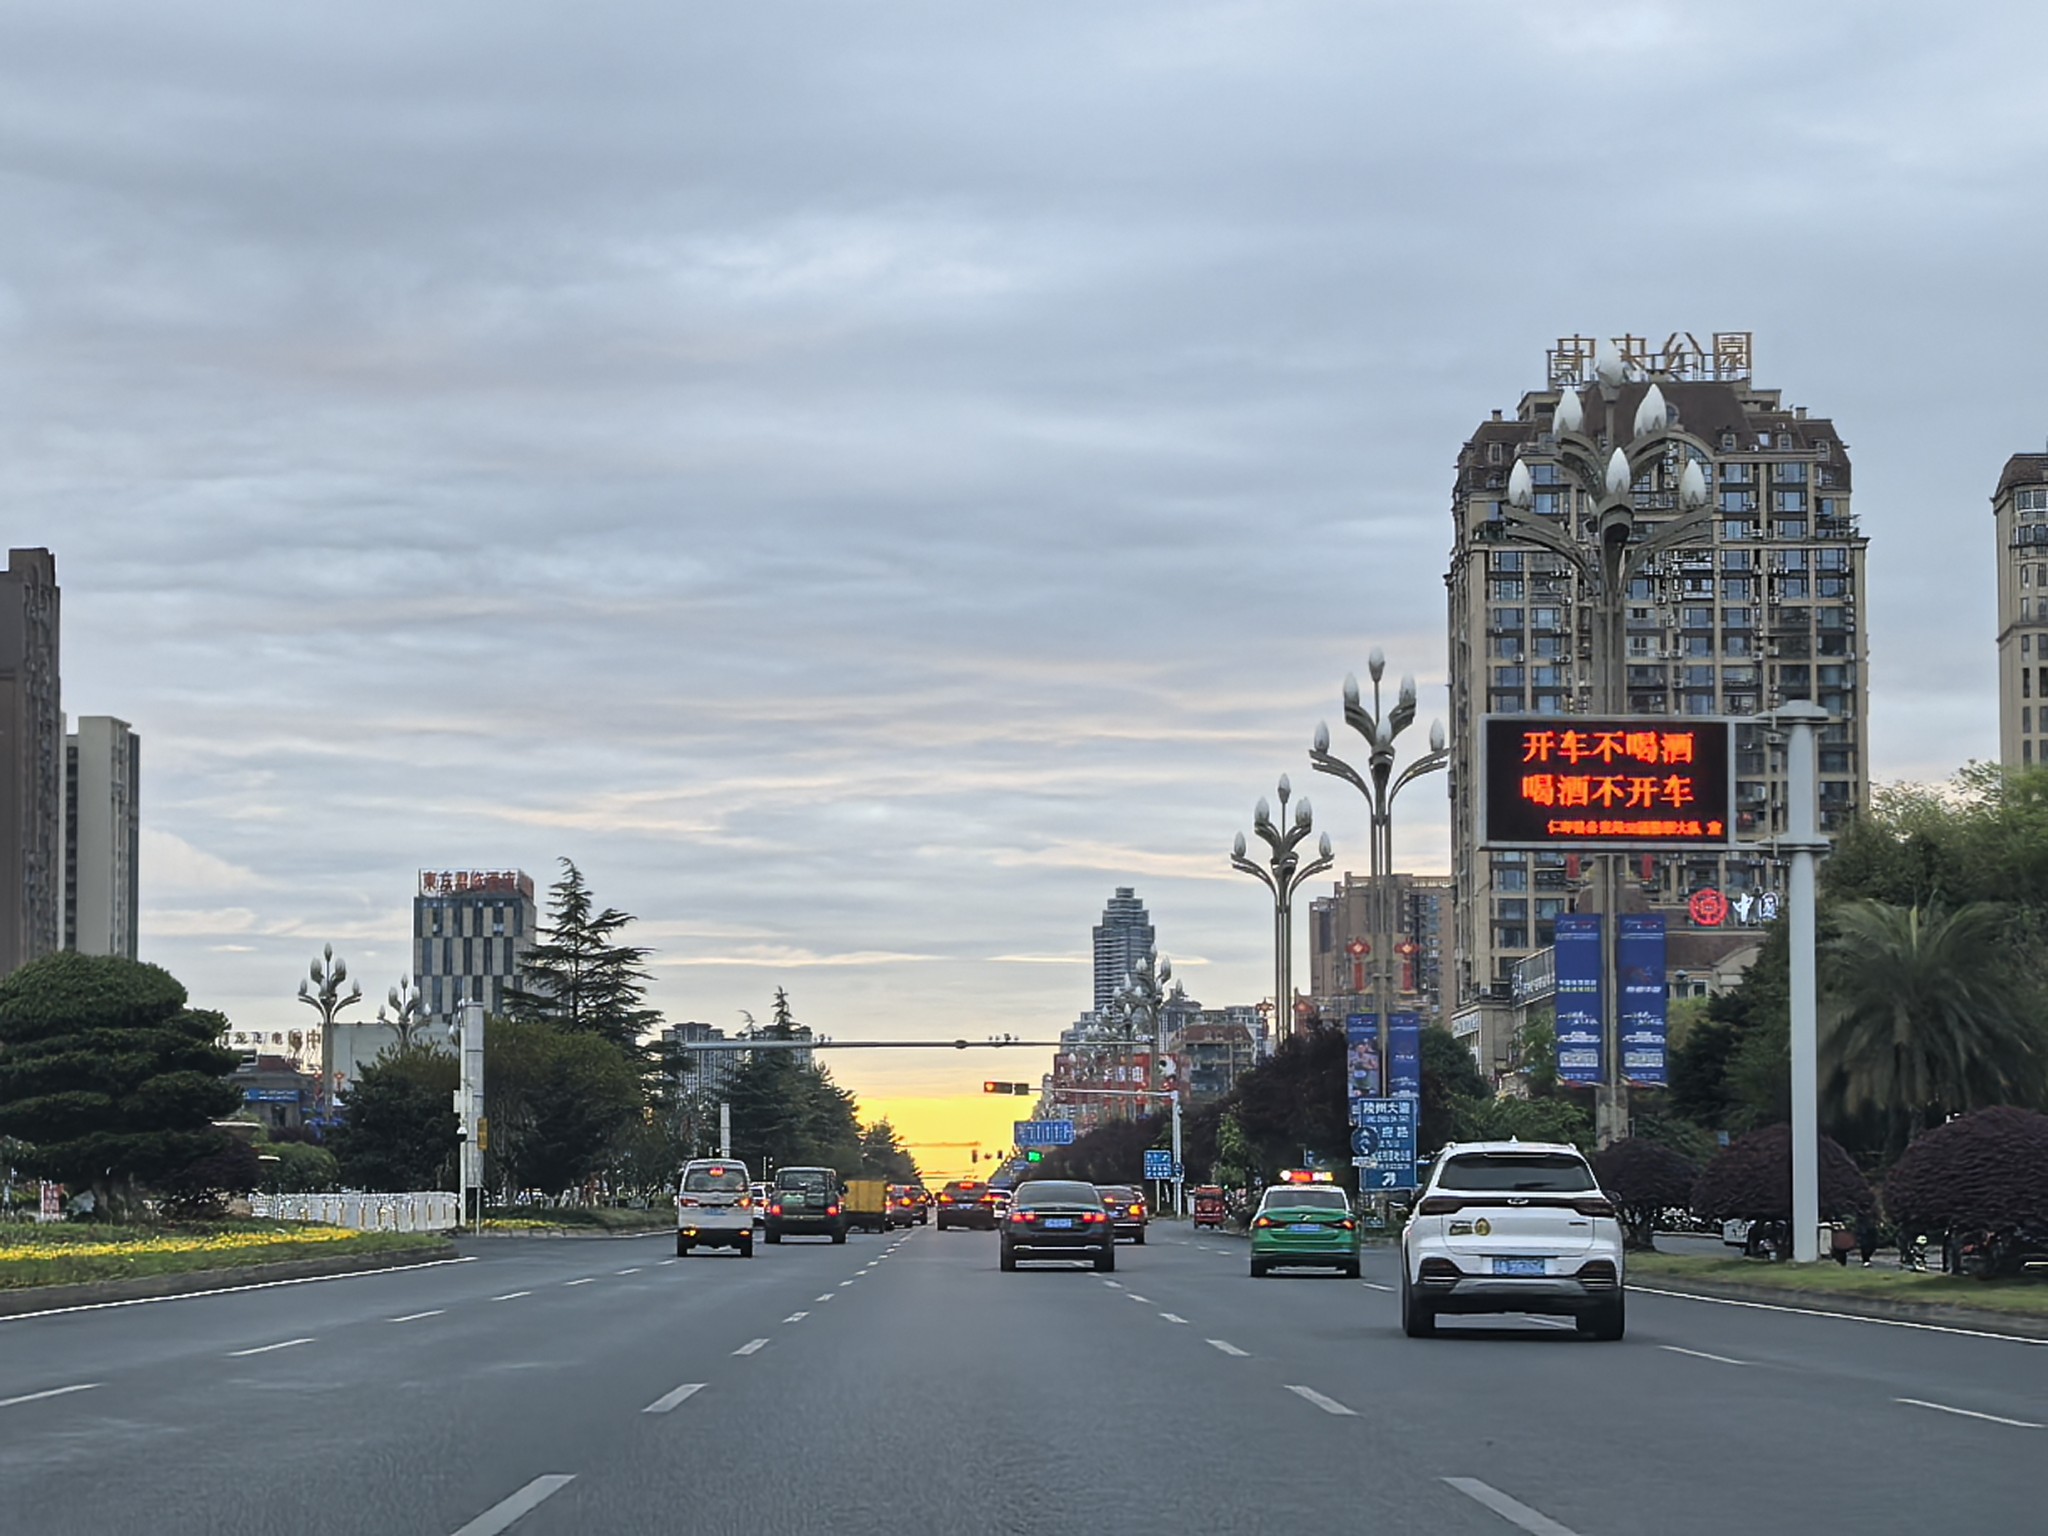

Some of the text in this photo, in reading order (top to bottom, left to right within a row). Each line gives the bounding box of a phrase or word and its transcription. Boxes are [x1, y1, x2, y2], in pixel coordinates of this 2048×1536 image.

[1523, 730, 1694, 764] 开车不喝酒
[1522, 774, 1694, 808] 喝酒不开车
